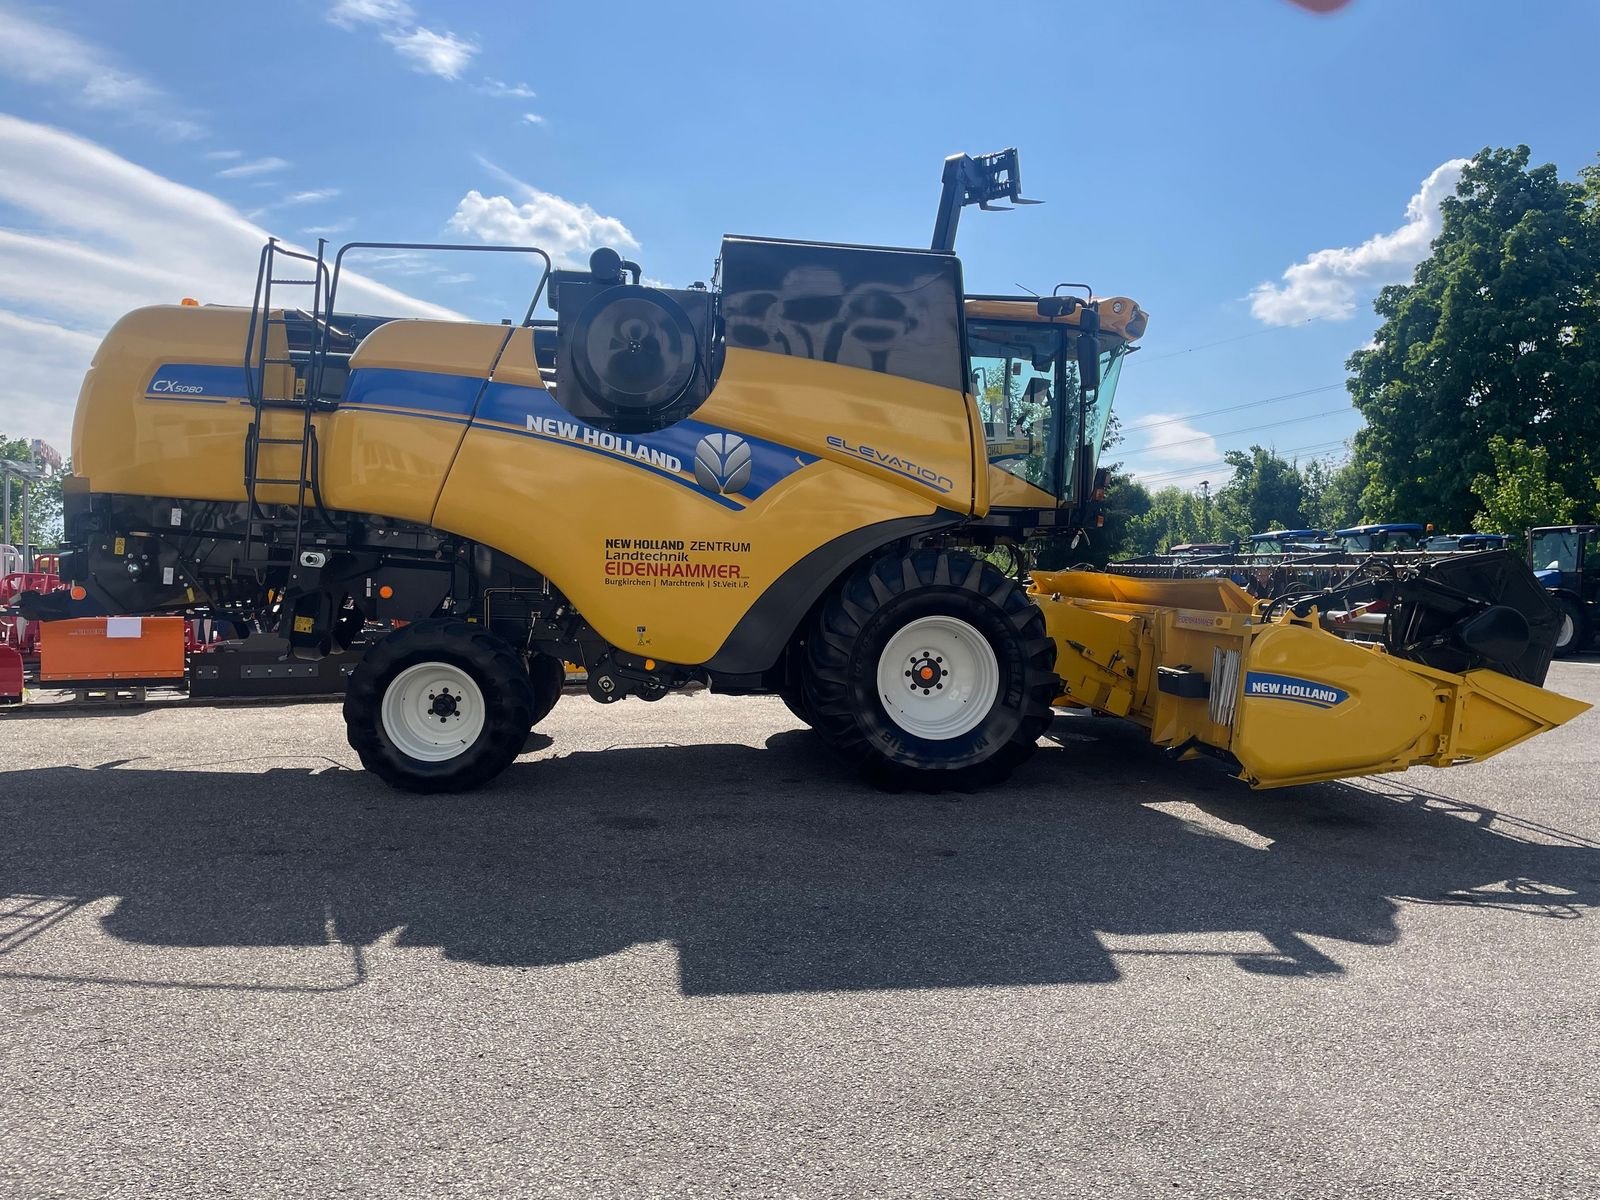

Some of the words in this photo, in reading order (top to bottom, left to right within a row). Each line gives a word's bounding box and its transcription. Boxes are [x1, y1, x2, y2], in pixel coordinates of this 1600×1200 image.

[153, 380, 203, 393] CX5080
[526, 414, 579, 440] NEW
[583, 427, 682, 473] HOLLAND
[826, 435, 953, 489] ELEVATION
[605, 538, 631, 549] NEW
[633, 539, 684, 551] HOLLAND
[690, 541, 751, 552] ZENTRUM
[605, 550, 689, 562] Landtechnik
[604, 561, 741, 579] EIDENHAMMER
[604, 577, 651, 587] Burgkirchen
[660, 579, 705, 588] Marchtrenk
[1252, 682, 1281, 694] NEW
[1282, 684, 1338, 703] HOLLAND
